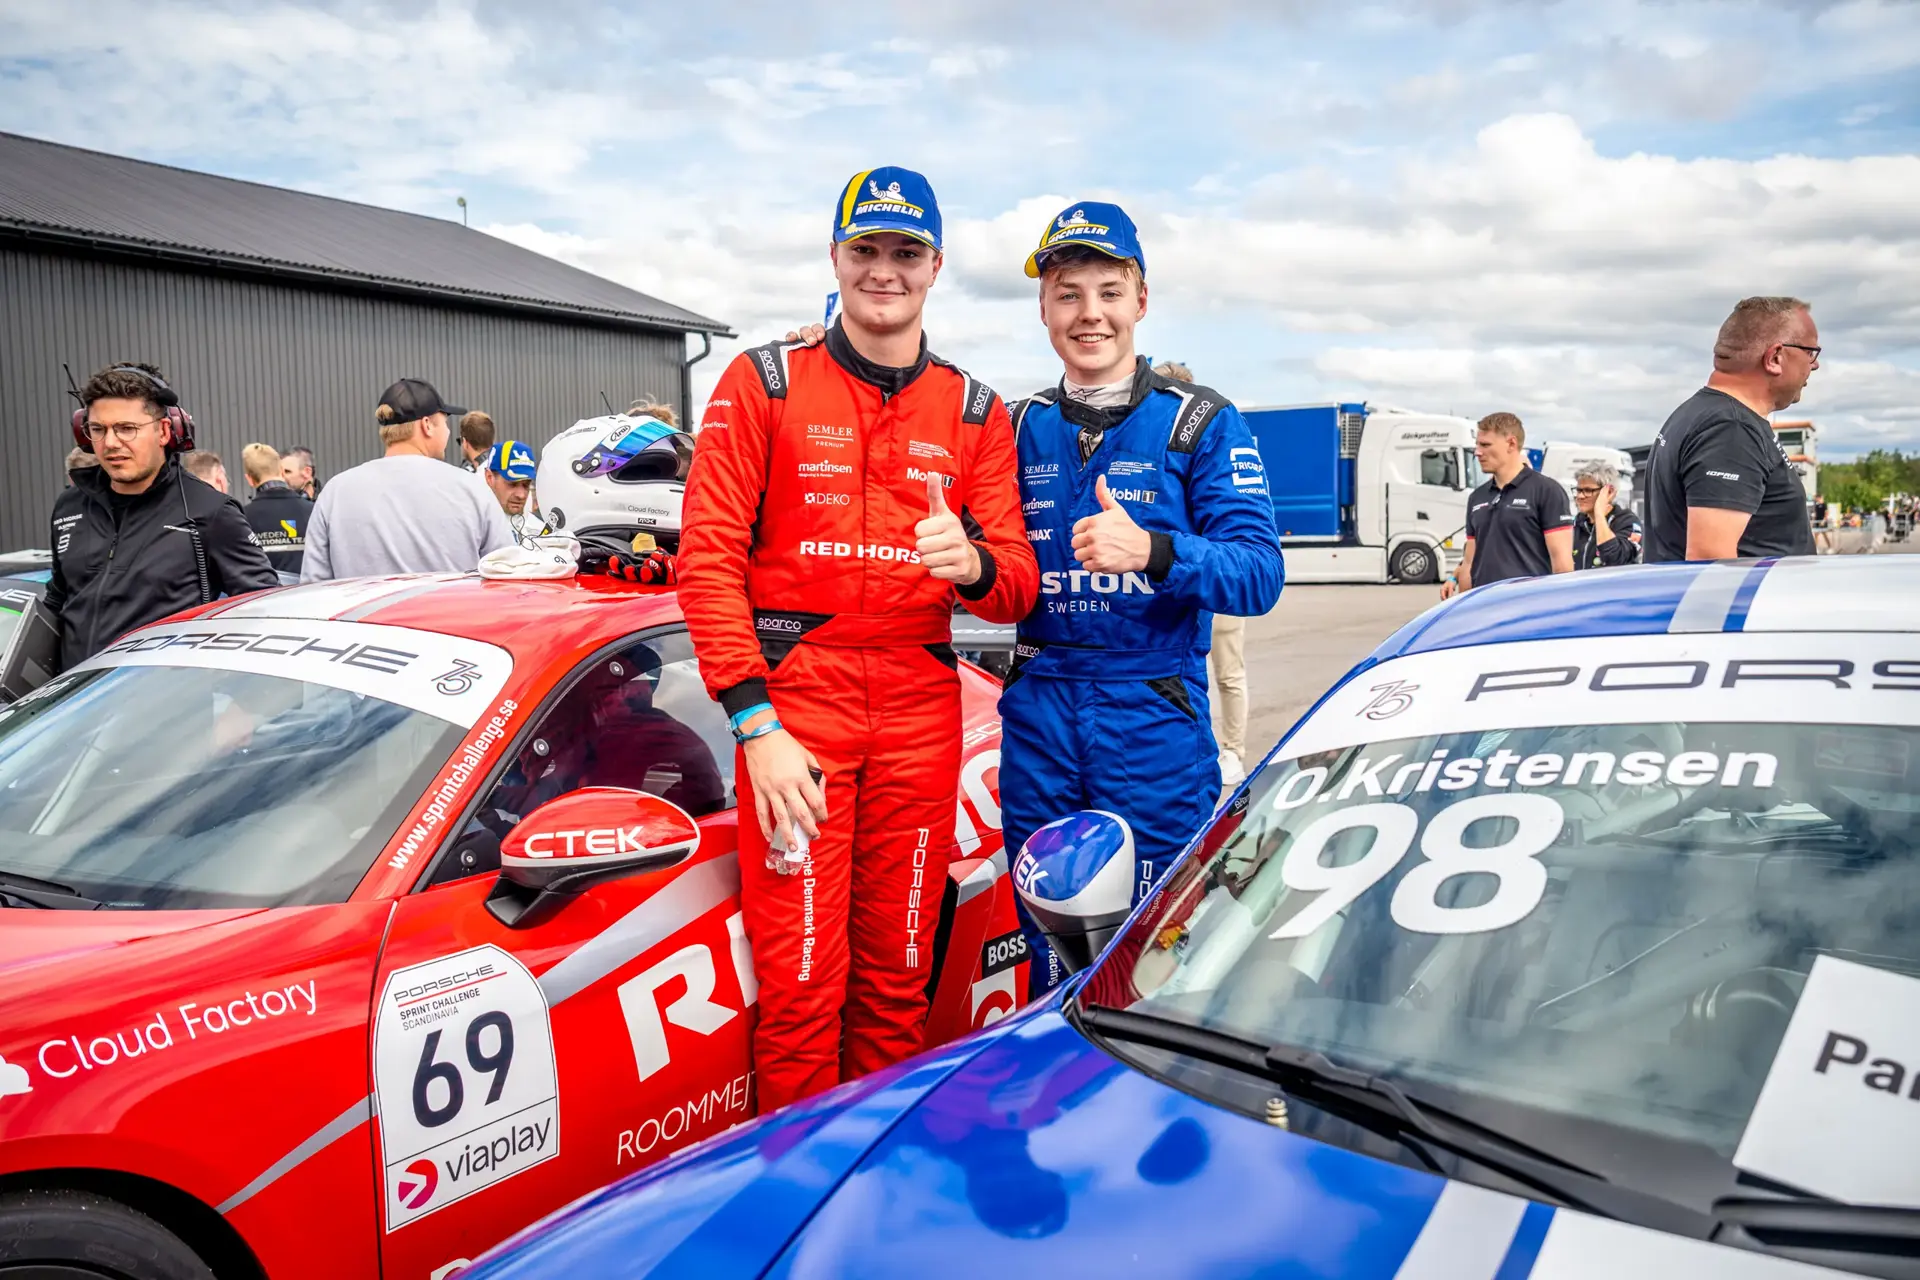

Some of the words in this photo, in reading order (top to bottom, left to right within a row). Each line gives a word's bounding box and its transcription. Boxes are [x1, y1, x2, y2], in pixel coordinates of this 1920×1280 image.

[855, 204, 923, 219] MICHELIN
[760, 350, 781, 390] sparco
[615, 426, 628, 439] Arai
[807, 424, 853, 437] SEMLER
[1180, 400, 1213, 443] sparco
[798, 459, 853, 474] martinsen
[1024, 463, 1059, 474] SEMLER
[627, 505, 647, 513] Cloud
[647, 507, 670, 516] Factory
[816, 493, 851, 506] DEKO
[800, 541, 851, 556] RED
[857, 544, 921, 564] HORS
[1039, 570, 1155, 594] STON
[1048, 600, 1110, 613] SWEDEN
[757, 617, 802, 632] sparco
[94, 633, 419, 674] PORSCHE
[388, 699, 518, 870] www.sprintchallenge.se
[524, 825, 648, 858] CTEK
[1267, 793, 1564, 941] 98
[803, 877, 816, 935] Denmark
[906, 828, 930, 969] PORSCHE
[797, 937, 816, 982] Racing
[987, 933, 1027, 968] BOSS
[394, 964, 494, 1002] PORSCHE
[400, 1003, 431, 1020] SPRINT
[432, 987, 481, 1010] CHALLENGE
[402, 1006, 459, 1031] SCANDINAVIA
[38, 1012, 174, 1078] Cloud
[179, 980, 317, 1040] Factory
[412, 1010, 514, 1128] 69
[616, 1070, 756, 1166] ROOMMEJ
[445, 1117, 552, 1182] viaplay
